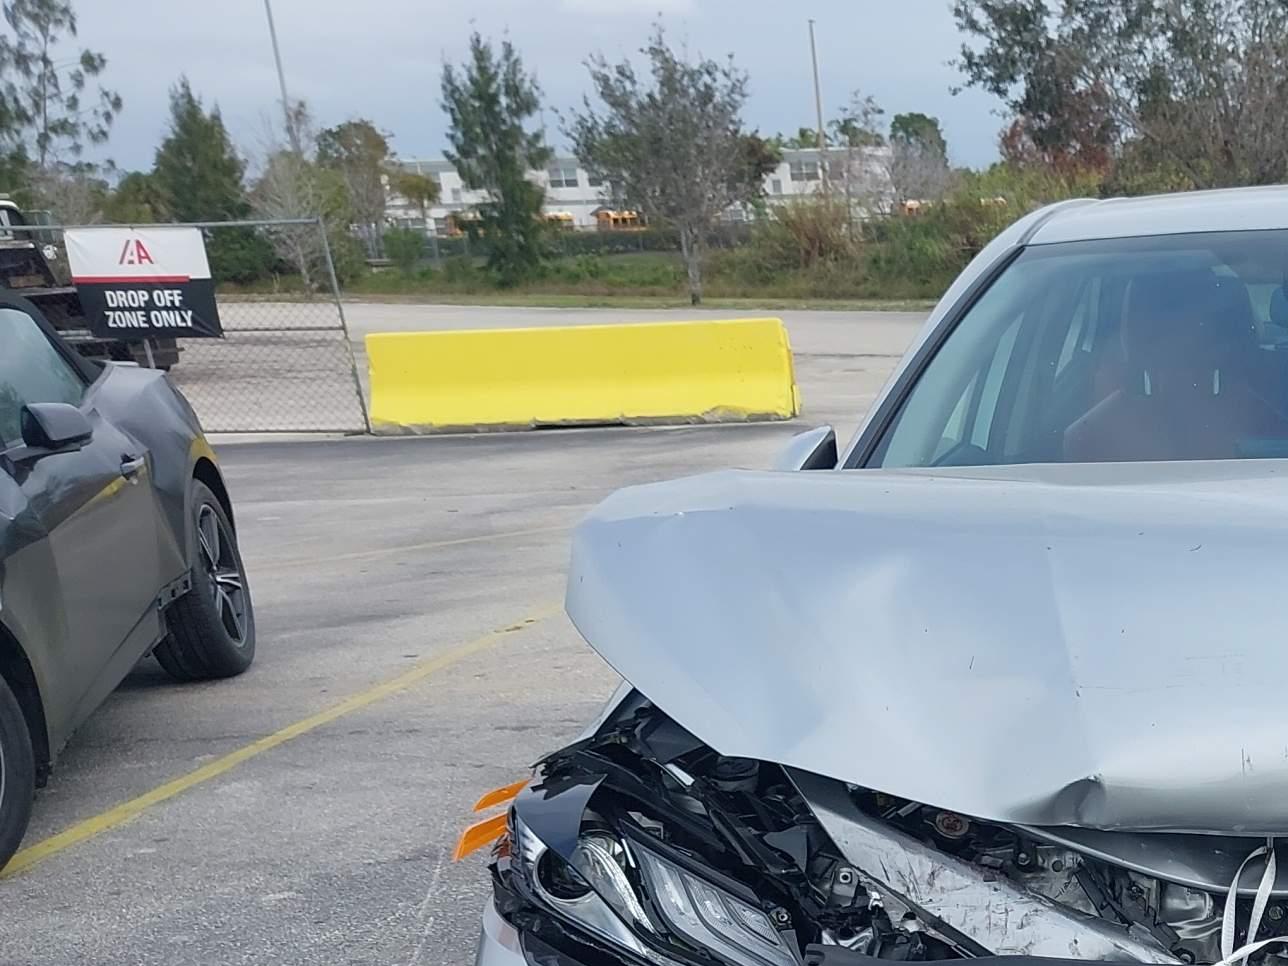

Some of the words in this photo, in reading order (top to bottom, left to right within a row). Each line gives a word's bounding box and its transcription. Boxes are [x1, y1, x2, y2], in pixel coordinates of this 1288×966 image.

[104, 290, 149, 307] DROP
[152, 289, 183, 307] OFF
[104, 310, 149, 328] ZONE
[150, 310, 192, 328] ONLY
